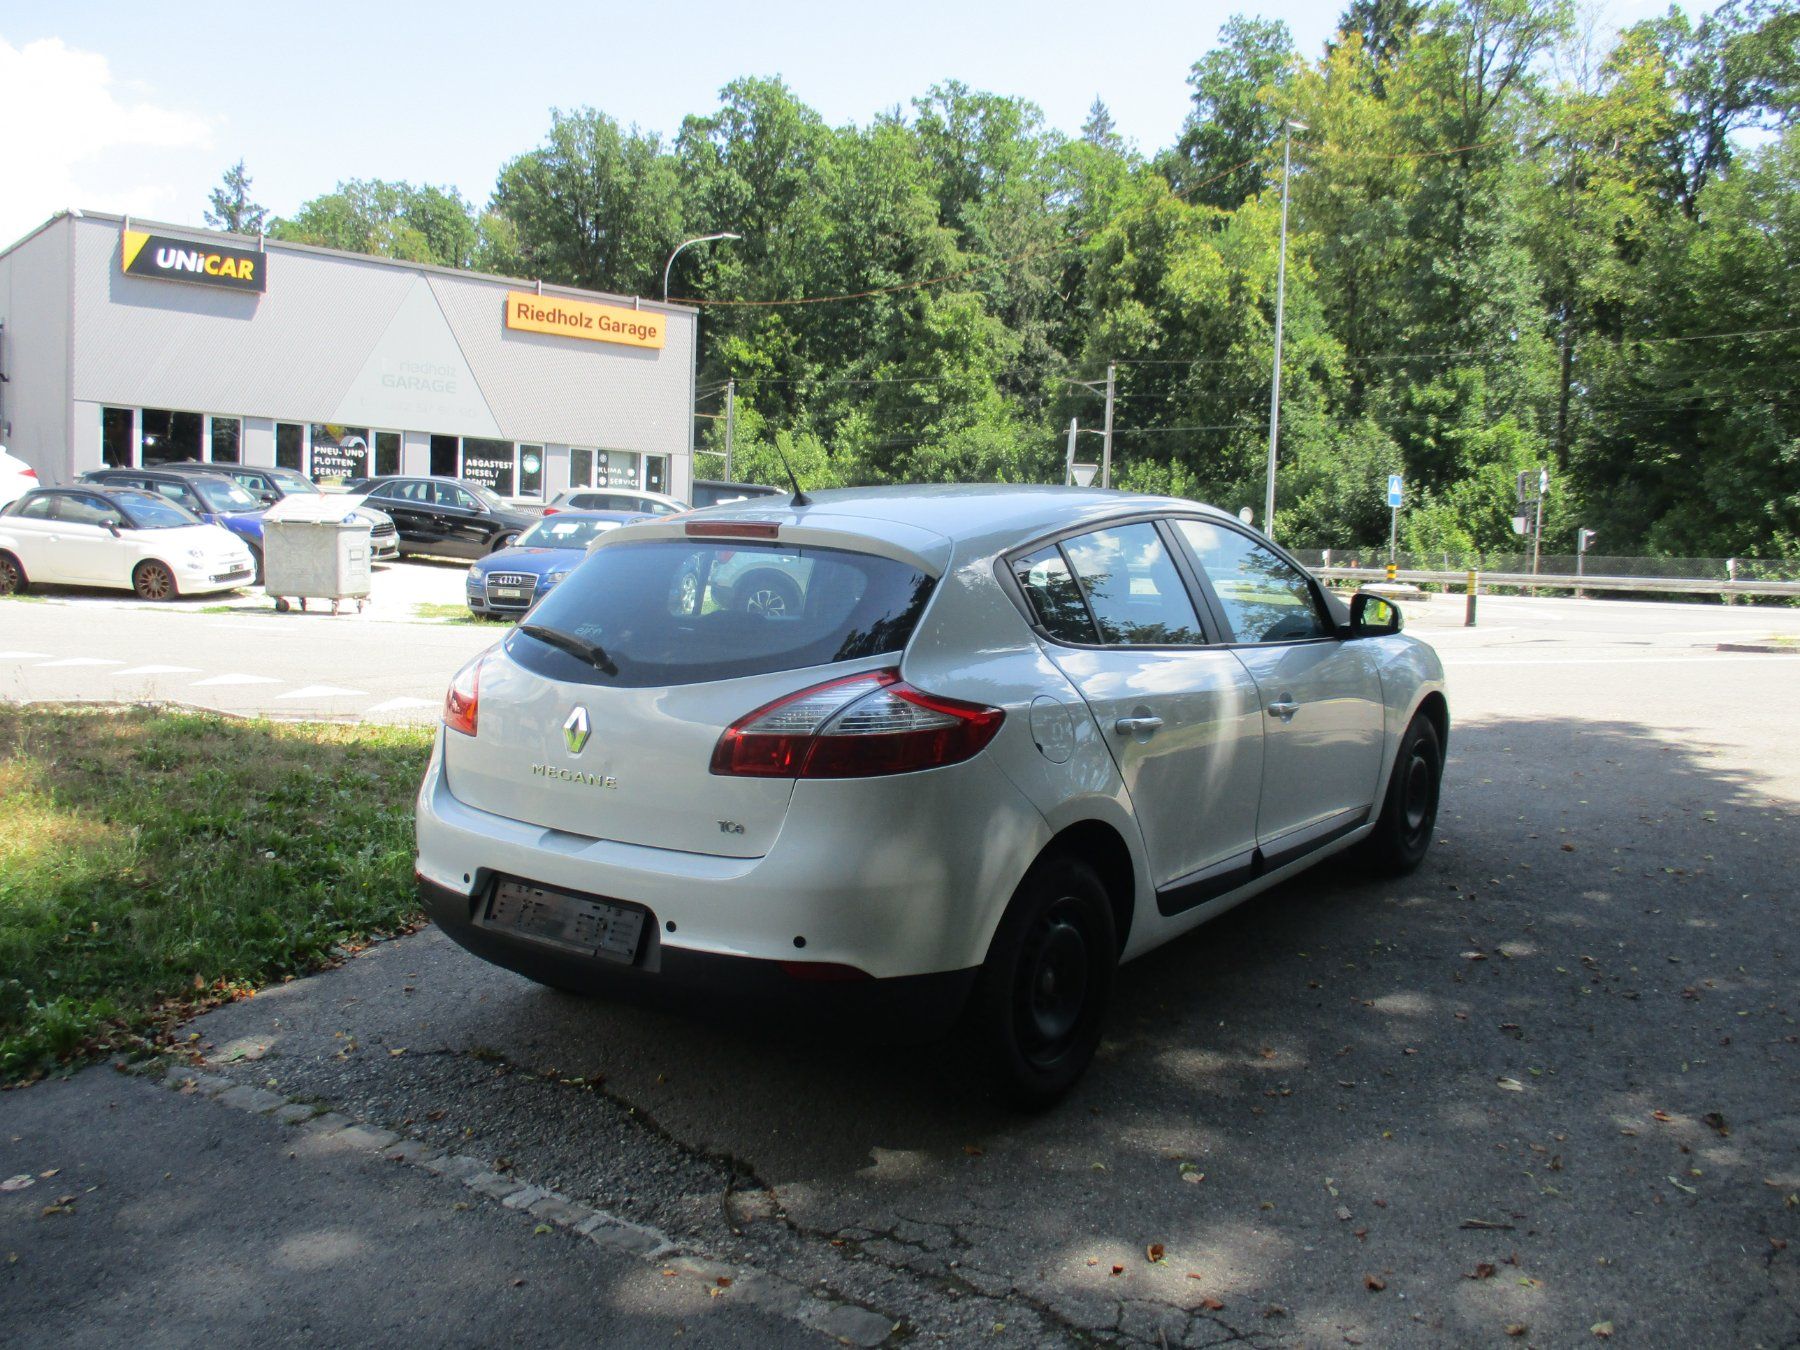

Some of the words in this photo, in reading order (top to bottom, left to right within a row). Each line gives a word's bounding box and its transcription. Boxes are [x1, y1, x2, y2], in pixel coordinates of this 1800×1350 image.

[517, 303, 593, 329] Riedholz
[598, 315, 657, 340] Garage
[381, 374, 457, 394] GARAGE
[314, 446, 342, 456] PNEU-
[345, 449, 364, 458] UND
[314, 456, 357, 467] FLOTTEN-
[466, 458, 514, 470] ABGASTEST
[314, 467, 352, 478] SERVICE
[466, 468, 494, 478] DIESEL
[598, 467, 622, 475] KLIMA
[610, 478, 640, 487] SERVICE
[716, 819, 745, 835] TCe
